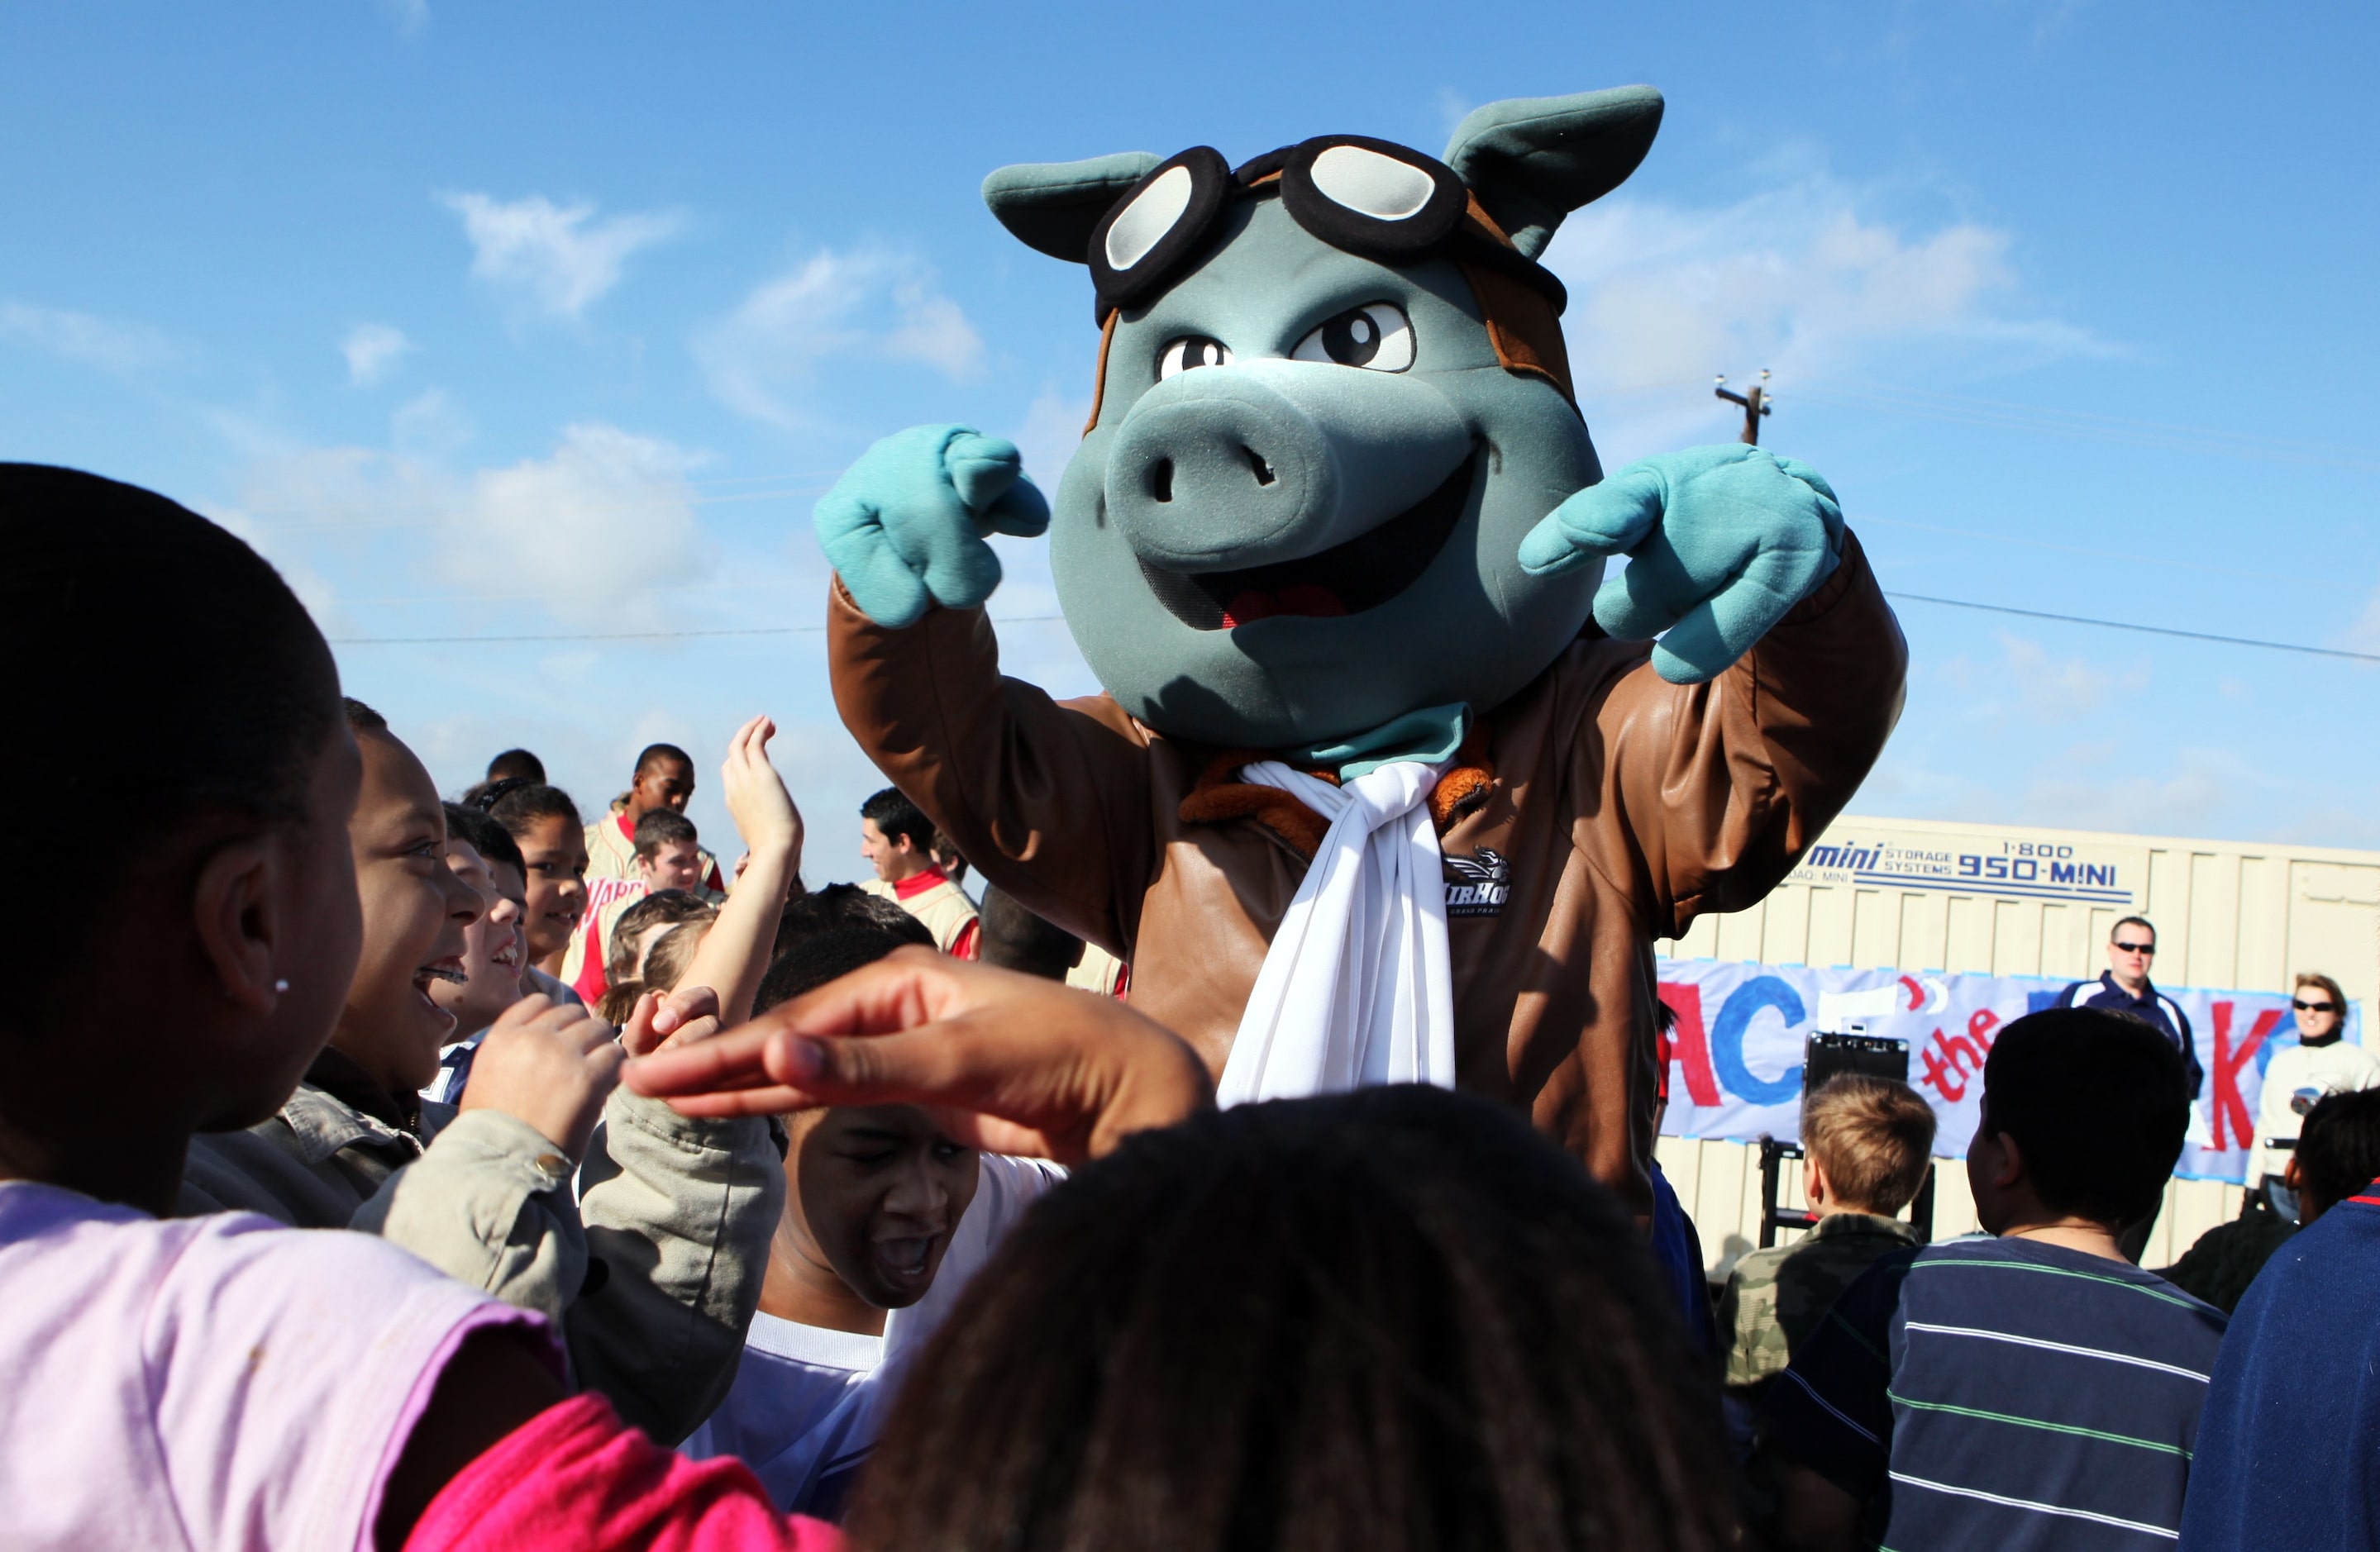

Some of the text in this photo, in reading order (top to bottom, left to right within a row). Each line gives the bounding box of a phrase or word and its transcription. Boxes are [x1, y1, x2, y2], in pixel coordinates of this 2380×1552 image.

[1807, 841, 1884, 870] mini
[1886, 848, 1953, 862] STORAGE
[1822, 872, 1848, 883] MINI
[1884, 861, 1953, 876] SYSTEMS
[1958, 854, 2116, 887] 950-MINI
[1920, 1007, 2002, 1103] the
